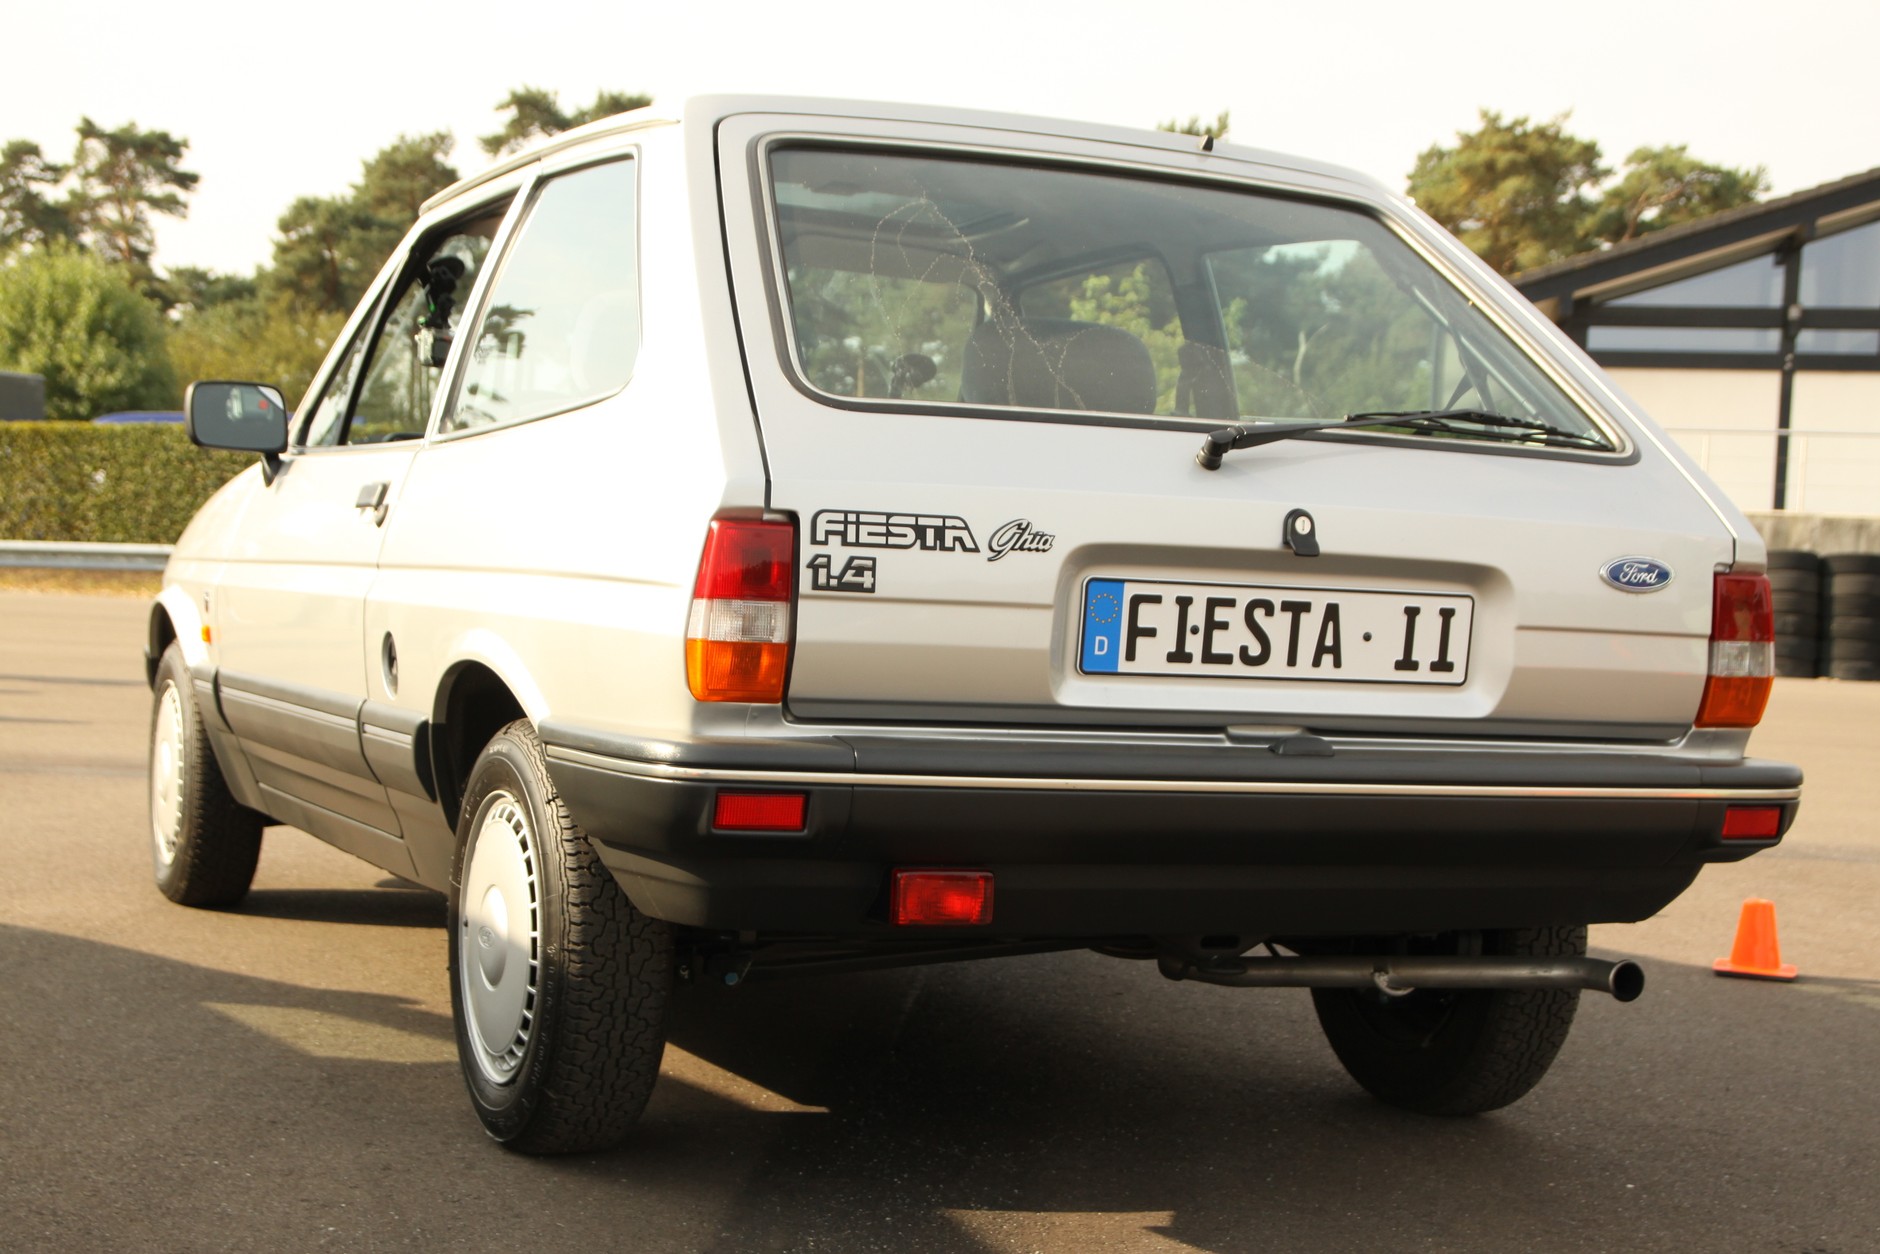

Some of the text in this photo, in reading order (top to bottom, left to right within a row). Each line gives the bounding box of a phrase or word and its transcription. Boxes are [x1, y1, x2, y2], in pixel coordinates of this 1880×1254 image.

[811, 509, 1055, 561] FIESTA Ghia
[806, 554, 877, 593] 1.4
[1619, 562, 1659, 584] Ford
[1094, 635, 1108, 655] D
[1125, 594, 1456, 672] FIESTA II
